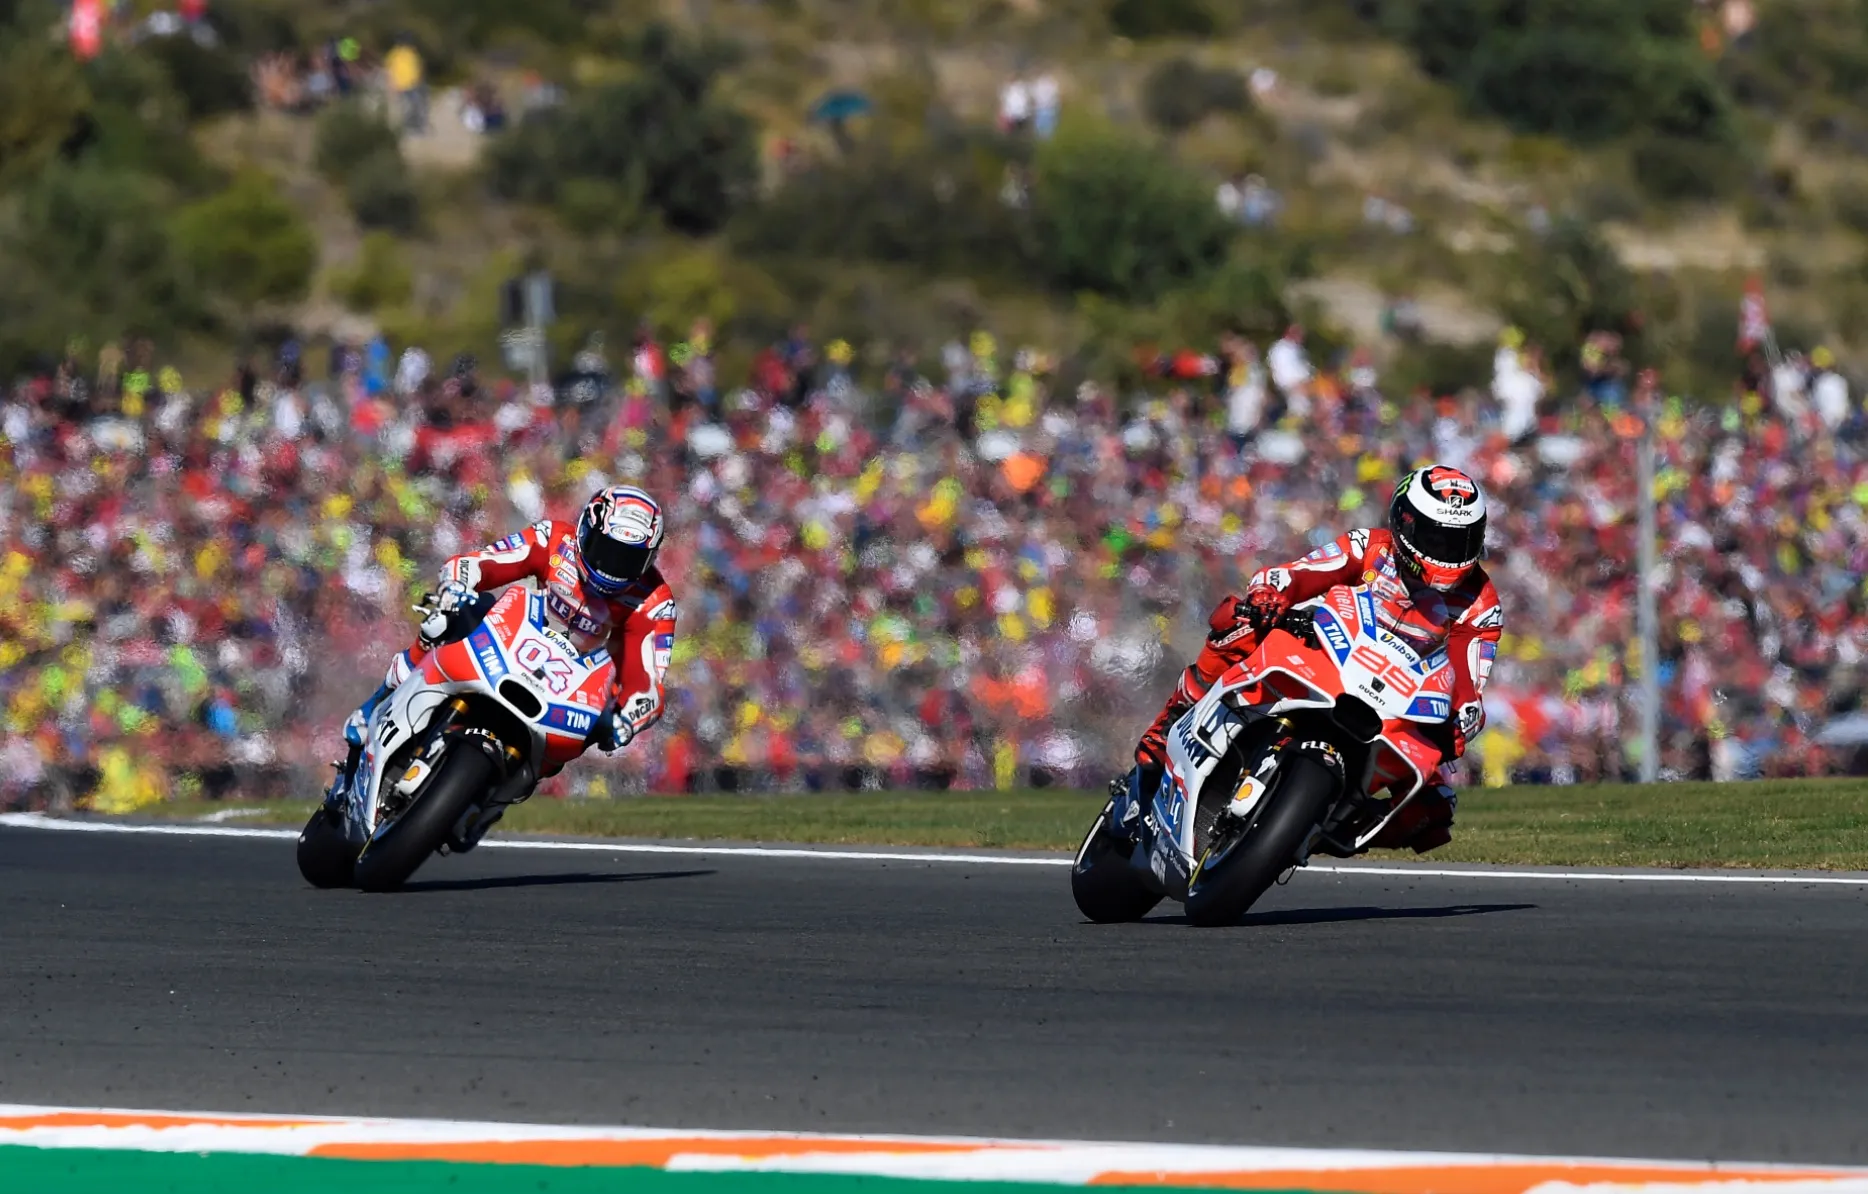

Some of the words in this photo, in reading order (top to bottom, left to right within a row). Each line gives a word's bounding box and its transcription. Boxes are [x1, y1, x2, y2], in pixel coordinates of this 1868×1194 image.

[1436, 508, 1473, 517] SHARK
[1380, 563, 1398, 578] TIM
[544, 630, 576, 658] Unibat
[1323, 622, 1349, 650] TIM
[1380, 632, 1416, 663] Unibat
[479, 645, 503, 676] TIM
[515, 637, 573, 696] 04
[1351, 645, 1420, 699] 99
[1358, 684, 1386, 706] DUCATI
[566, 710, 591, 730] TIM
[628, 699, 655, 721] DUCATI
[1177, 706, 1211, 769] DUCATI
